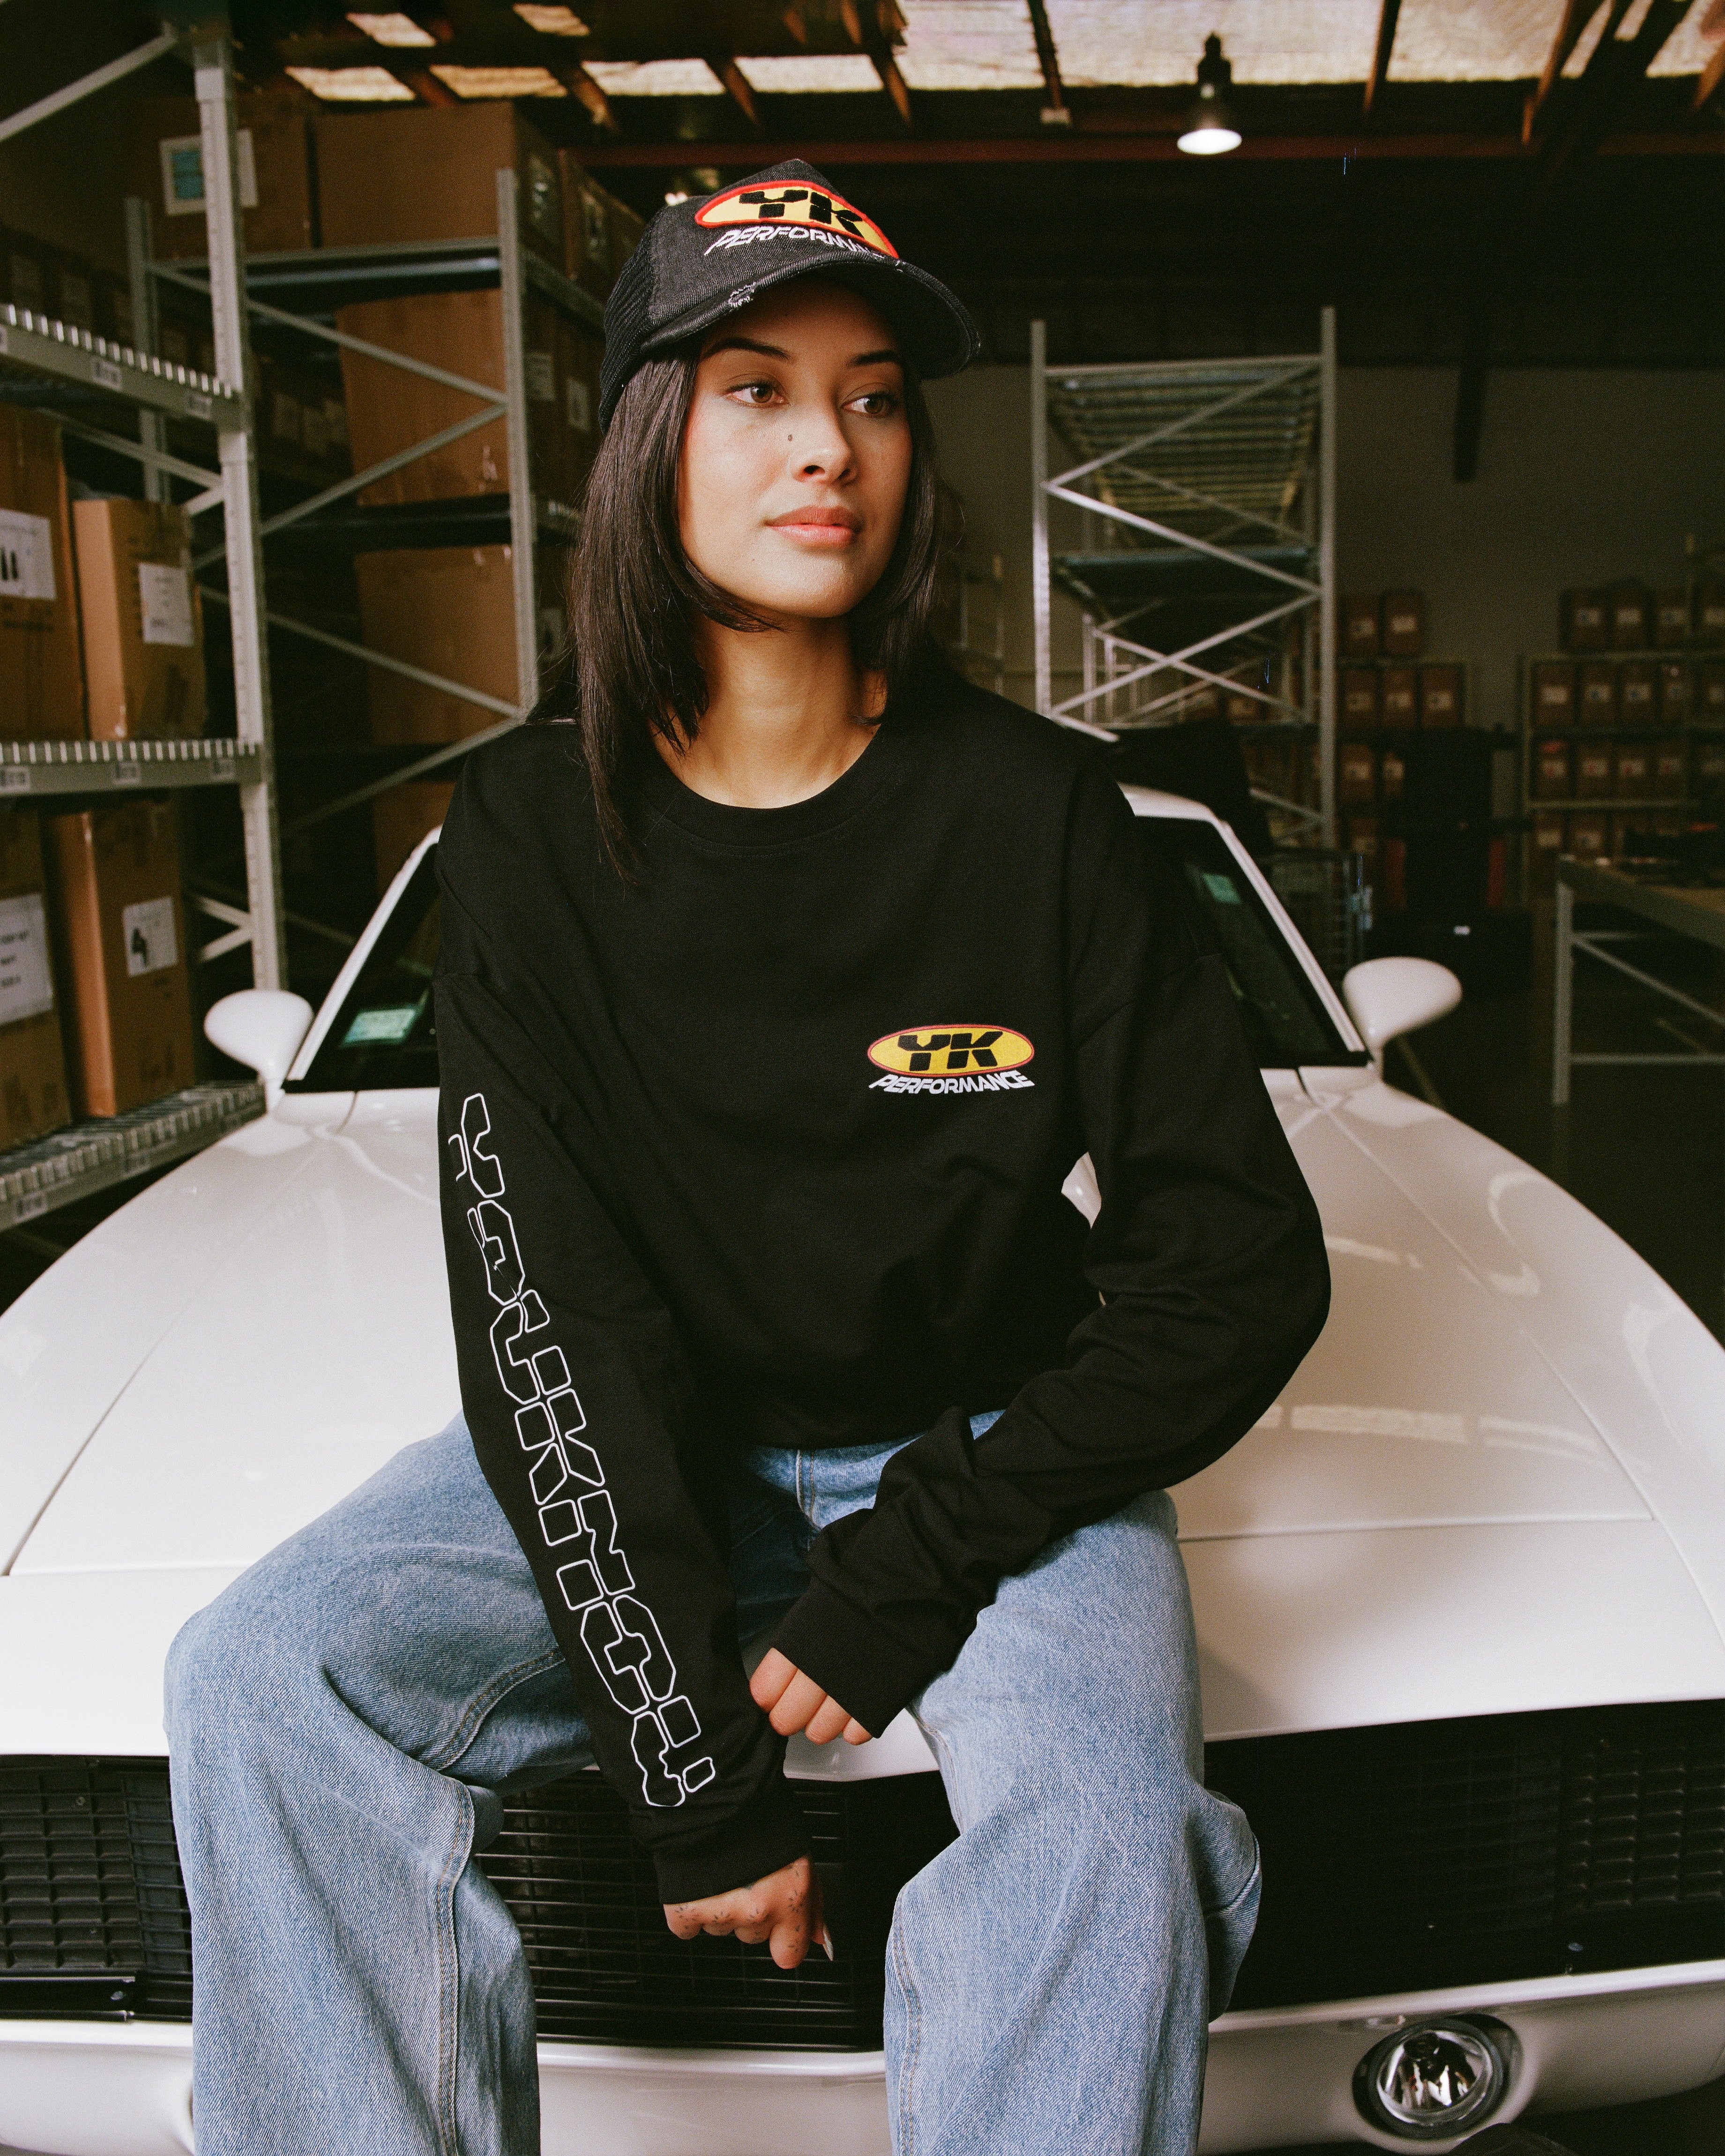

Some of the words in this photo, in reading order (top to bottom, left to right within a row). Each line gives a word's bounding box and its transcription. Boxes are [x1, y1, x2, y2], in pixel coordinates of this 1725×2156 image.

[739, 189, 863, 239] YK
[897, 1031, 1003, 1072] YK
[868, 1070, 1035, 1095] PERFORMANCE
